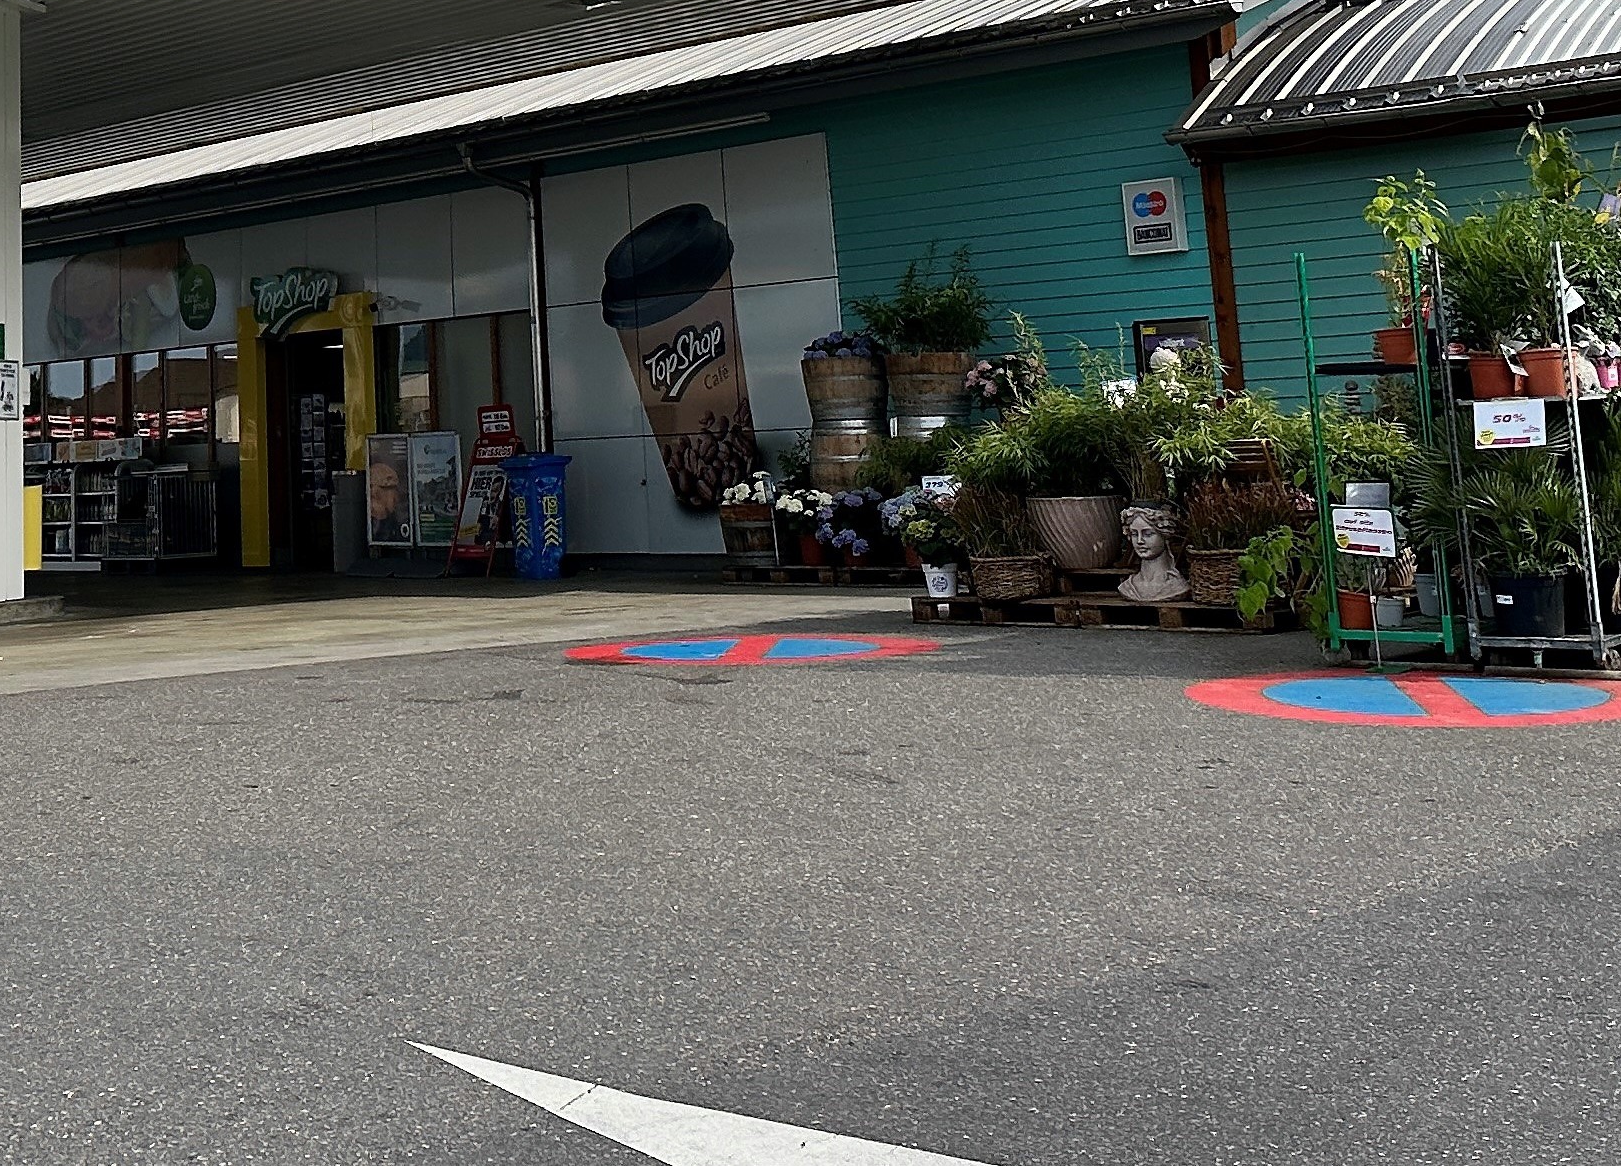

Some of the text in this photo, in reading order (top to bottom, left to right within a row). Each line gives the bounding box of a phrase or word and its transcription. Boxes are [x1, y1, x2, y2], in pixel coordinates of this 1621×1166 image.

[644, 326, 722, 386] TopShop
[703, 364, 729, 390] Café
[1492, 413, 1526, 424] 50%
